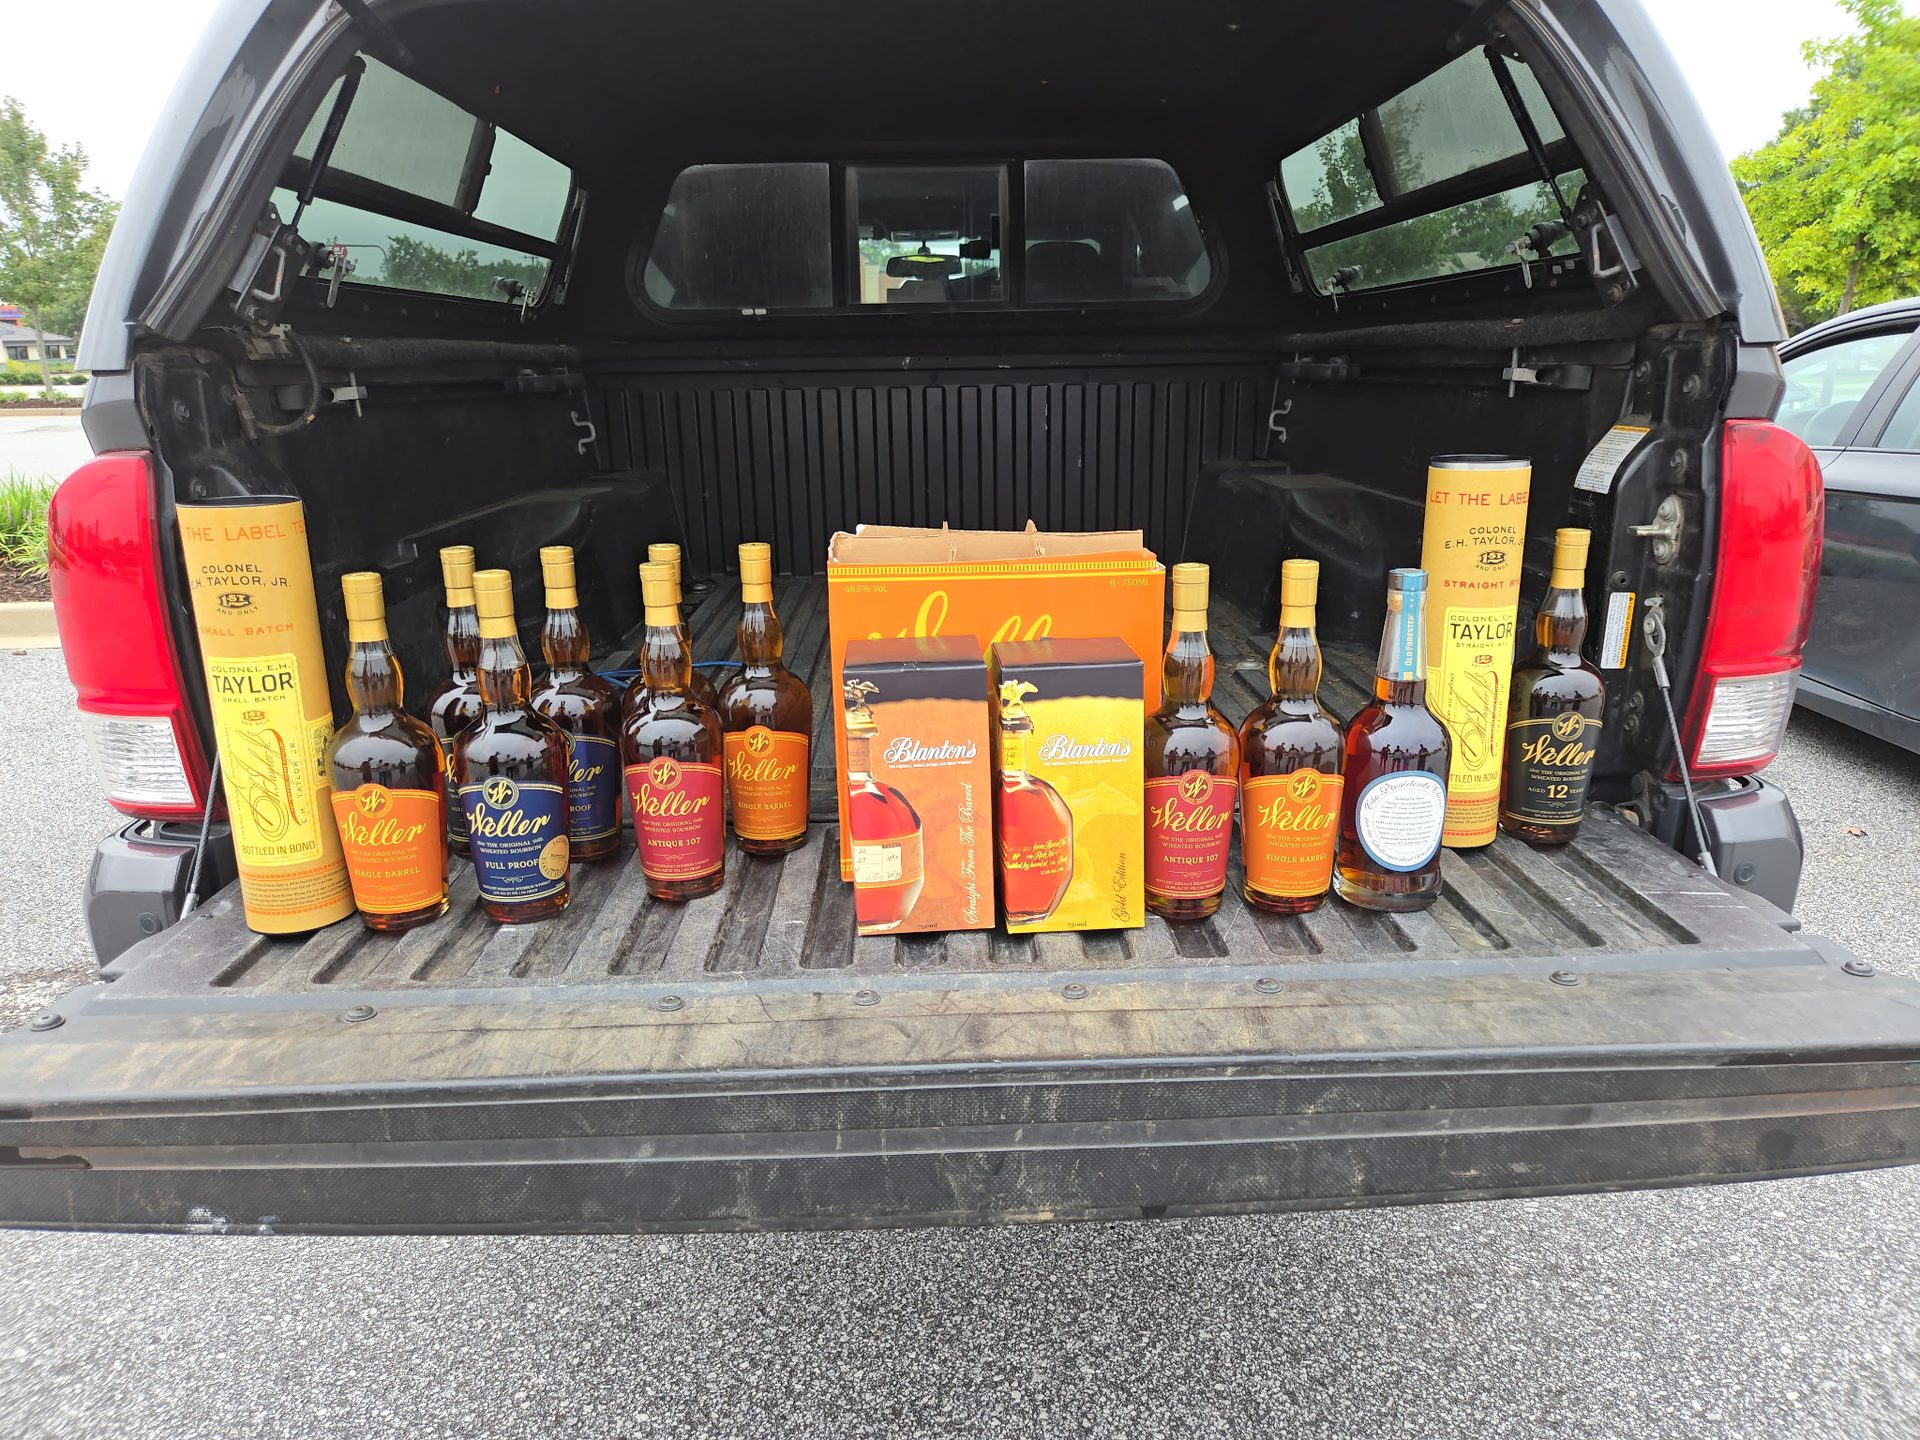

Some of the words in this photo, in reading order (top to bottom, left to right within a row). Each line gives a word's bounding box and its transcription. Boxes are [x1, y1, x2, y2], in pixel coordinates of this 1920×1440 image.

[1429, 491, 1450, 504] LET
[1458, 493, 1491, 506] THE
[1500, 491, 1528, 506] LABE
[185, 526, 214, 542] THE
[224, 524, 287, 541] LABEL
[1469, 526, 1516, 535] COLONEL
[1445, 539, 1468, 549] E.H.
[202, 564, 262, 574] COLONEL
[1475, 563, 1489, 571] AND
[207, 576, 266, 588] TAYLOR,
[271, 577, 292, 588] JR.
[1443, 579, 1505, 589] STRAIGHT
[216, 607, 232, 616] AND
[238, 605, 258, 616] ONLY
[201, 626, 236, 637] SMALL
[245, 622, 294, 636] BATCH
[1405, 613, 1415, 651] FORESTER
[1450, 622, 1513, 640] TAYLOR
[1405, 651, 1413, 667] OLD
[267, 663, 291, 671] E.H.
[213, 671, 294, 694] TAYLOR
[255, 694, 285, 703] BATCH
[883, 736, 977, 764] Blanton's
[1039, 734, 1132, 761] Blanton's
[1521, 734, 1597, 767] Weller
[728, 751, 799, 782] Weller
[292, 760, 303, 798] TAYLOR
[1450, 773, 1473, 783] TTLED
[1474, 775, 1482, 783] IN
[1527, 786, 1545, 794] AGED
[1547, 784, 1569, 799] 12
[632, 783, 711, 816] Weller
[738, 801, 762, 810] SINGLE
[764, 801, 792, 810] BARREL
[958, 781, 974, 823] Barrel
[570, 804, 592, 812] ROOF
[1150, 797, 1231, 832] Weller
[1257, 796, 1337, 832] Weller
[466, 803, 551, 837] Weller
[340, 811, 427, 847] Weller
[960, 826, 975, 847] The
[242, 844, 274, 856] BOTTLED
[277, 845, 287, 855] IN
[289, 840, 316, 854] BOND
[480, 847, 508, 855] WHEATED
[510, 844, 541, 854] BOURBON
[499, 840, 532, 849] ORIGINAL
[648, 839, 684, 848] ANTIQUE
[687, 837, 701, 846] 107
[1162, 841, 1193, 849] WHEATED
[485, 861, 506, 870] FULL
[508, 858, 539, 870] PROOF
[961, 848, 976, 881] From
[1163, 855, 1203, 865] ANTIQUE
[1206, 853, 1219, 863] 107
[1265, 853, 1297, 863] SINGLE
[1300, 852, 1327, 863] BARREL
[355, 869, 382, 879] SINGLE
[385, 867, 420, 878] BARREL
[1112, 852, 1127, 892] Edition
[961, 882, 983, 925] Straight
[1111, 893, 1130, 922] Gold
